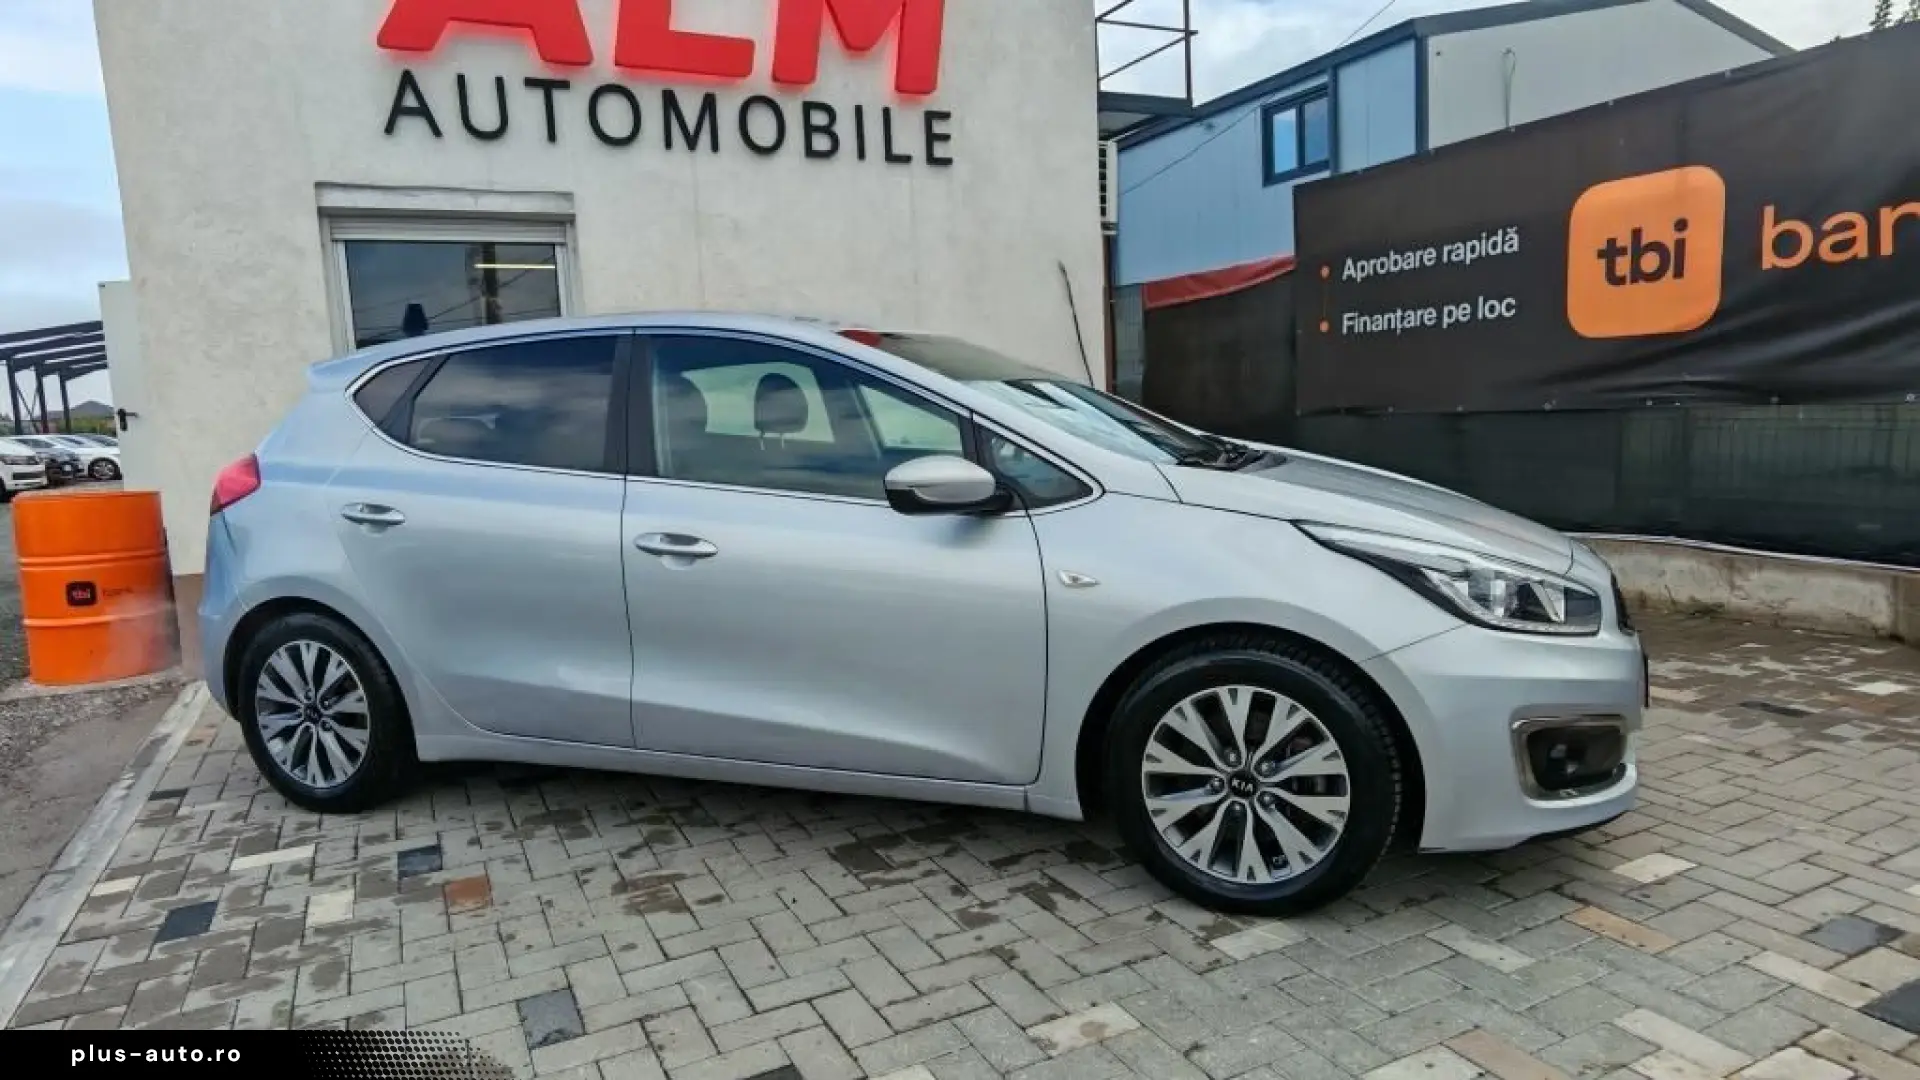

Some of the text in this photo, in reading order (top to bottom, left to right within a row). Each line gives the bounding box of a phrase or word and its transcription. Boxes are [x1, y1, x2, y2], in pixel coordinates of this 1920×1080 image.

[384, 68, 954, 167] AUTOMOBILE
[1341, 225, 1520, 284] Aprobare rapidă
[1597, 217, 1690, 286] tbi
[1341, 295, 1516, 337] Finanțare pe loc
